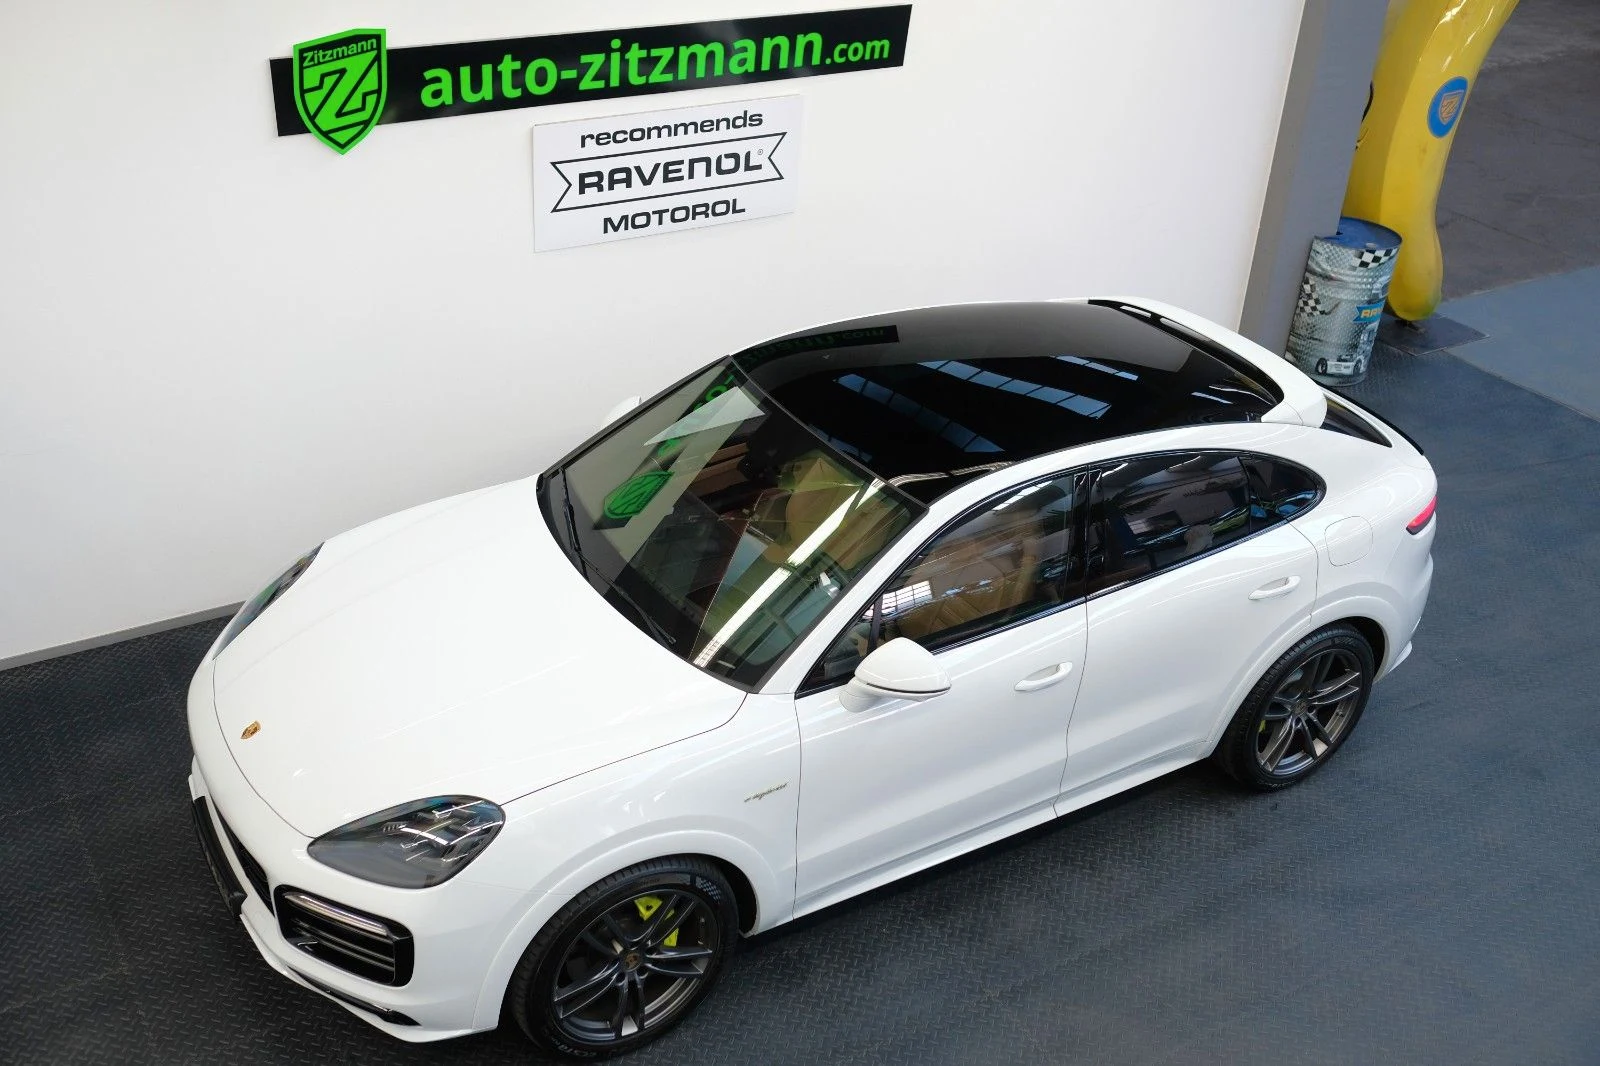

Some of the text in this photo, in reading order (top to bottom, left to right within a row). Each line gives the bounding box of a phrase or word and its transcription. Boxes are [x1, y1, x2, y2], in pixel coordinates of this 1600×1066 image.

[302, 38, 377, 67] Zitzmann
[420, 31, 890, 108] auto-zitzmann.com
[580, 110, 763, 148] recommends
[603, 198, 746, 234] MOTOROL
